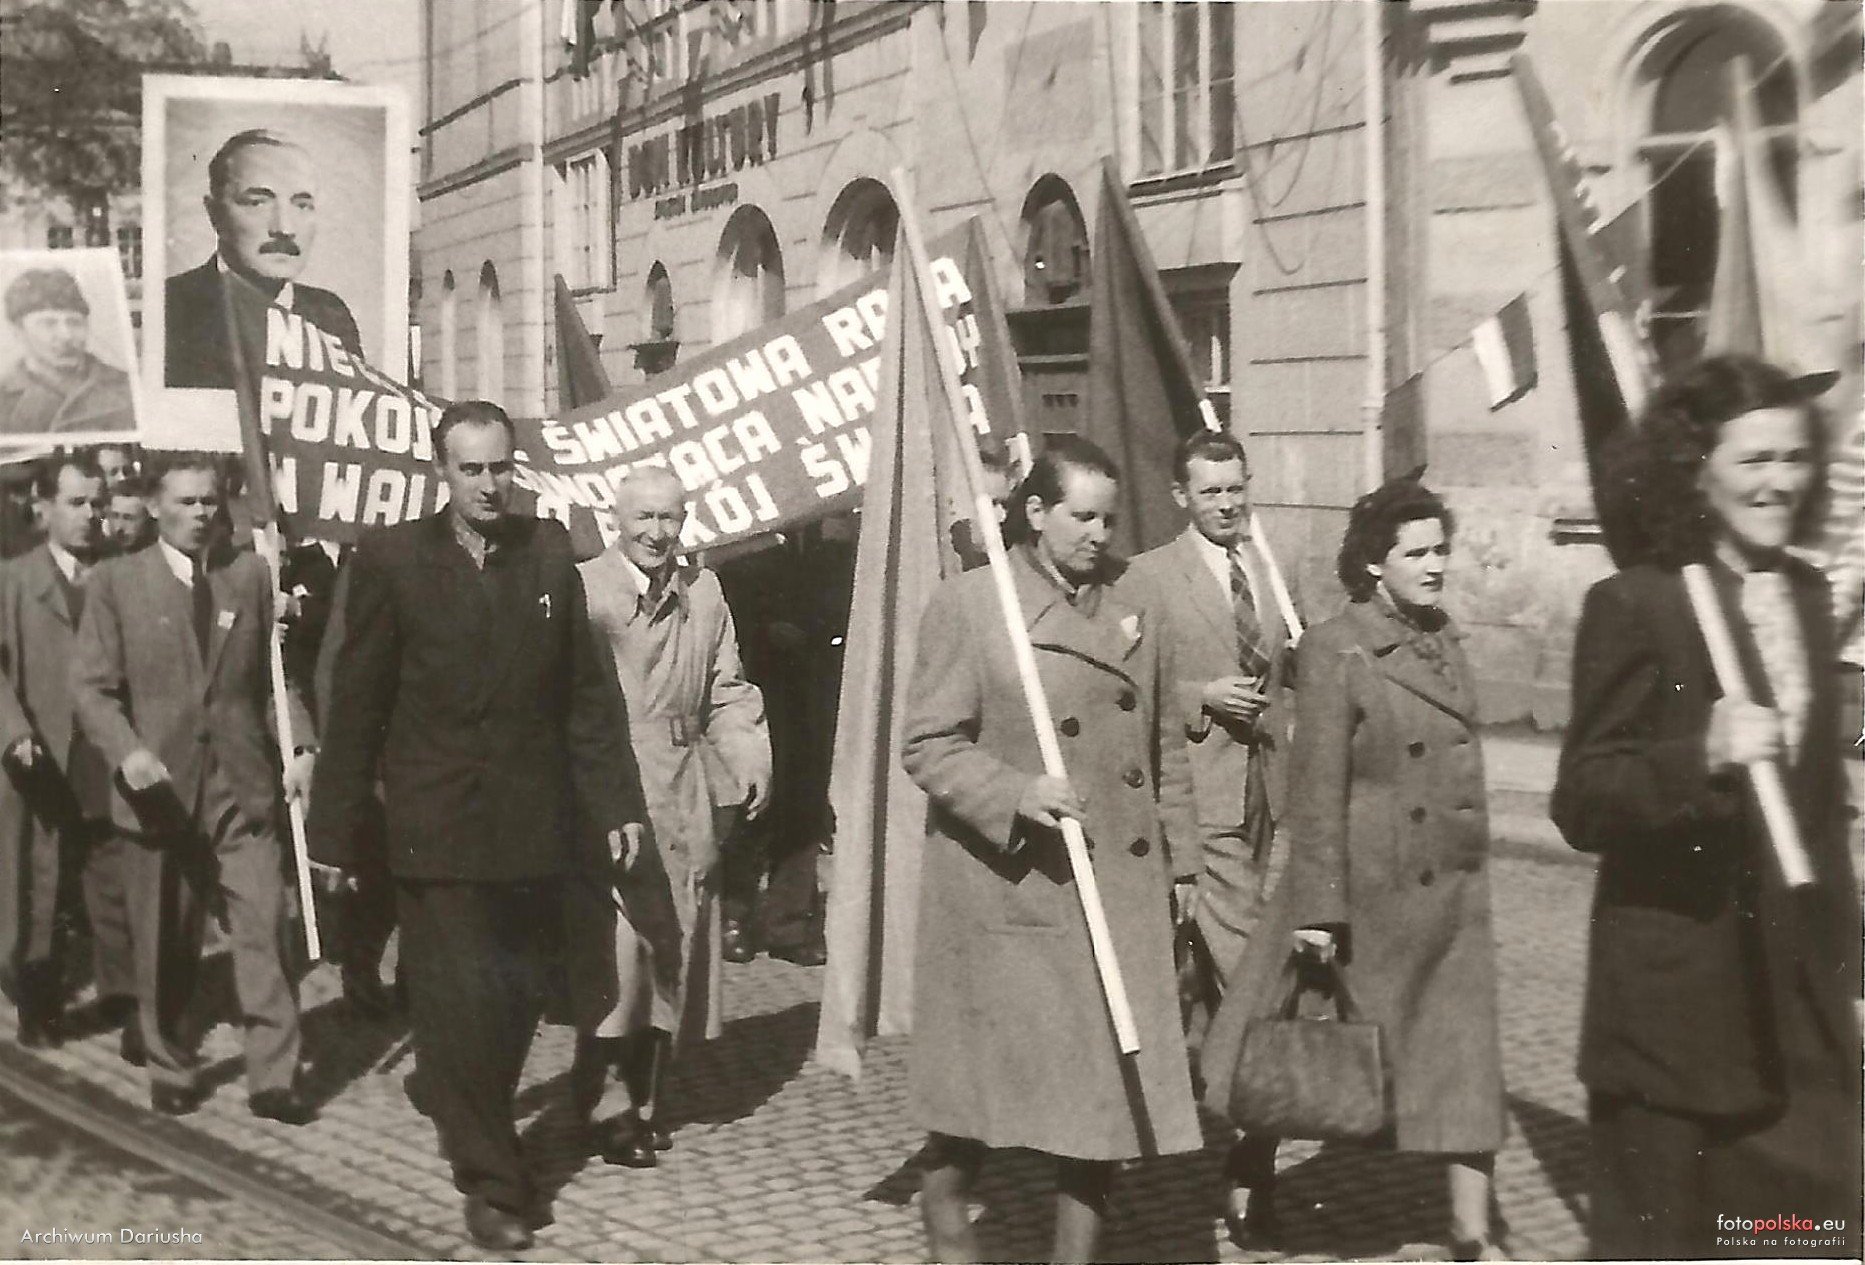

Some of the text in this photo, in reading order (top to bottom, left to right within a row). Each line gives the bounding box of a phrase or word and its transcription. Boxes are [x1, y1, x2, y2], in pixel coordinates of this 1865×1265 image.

[266, 307, 357, 377] NIE
[541, 334, 812, 465] ŚWIATOWA
[822, 257, 972, 357] RAA
[261, 376, 433, 461] POKOJ
[594, 473, 780, 549] PKÓJ
